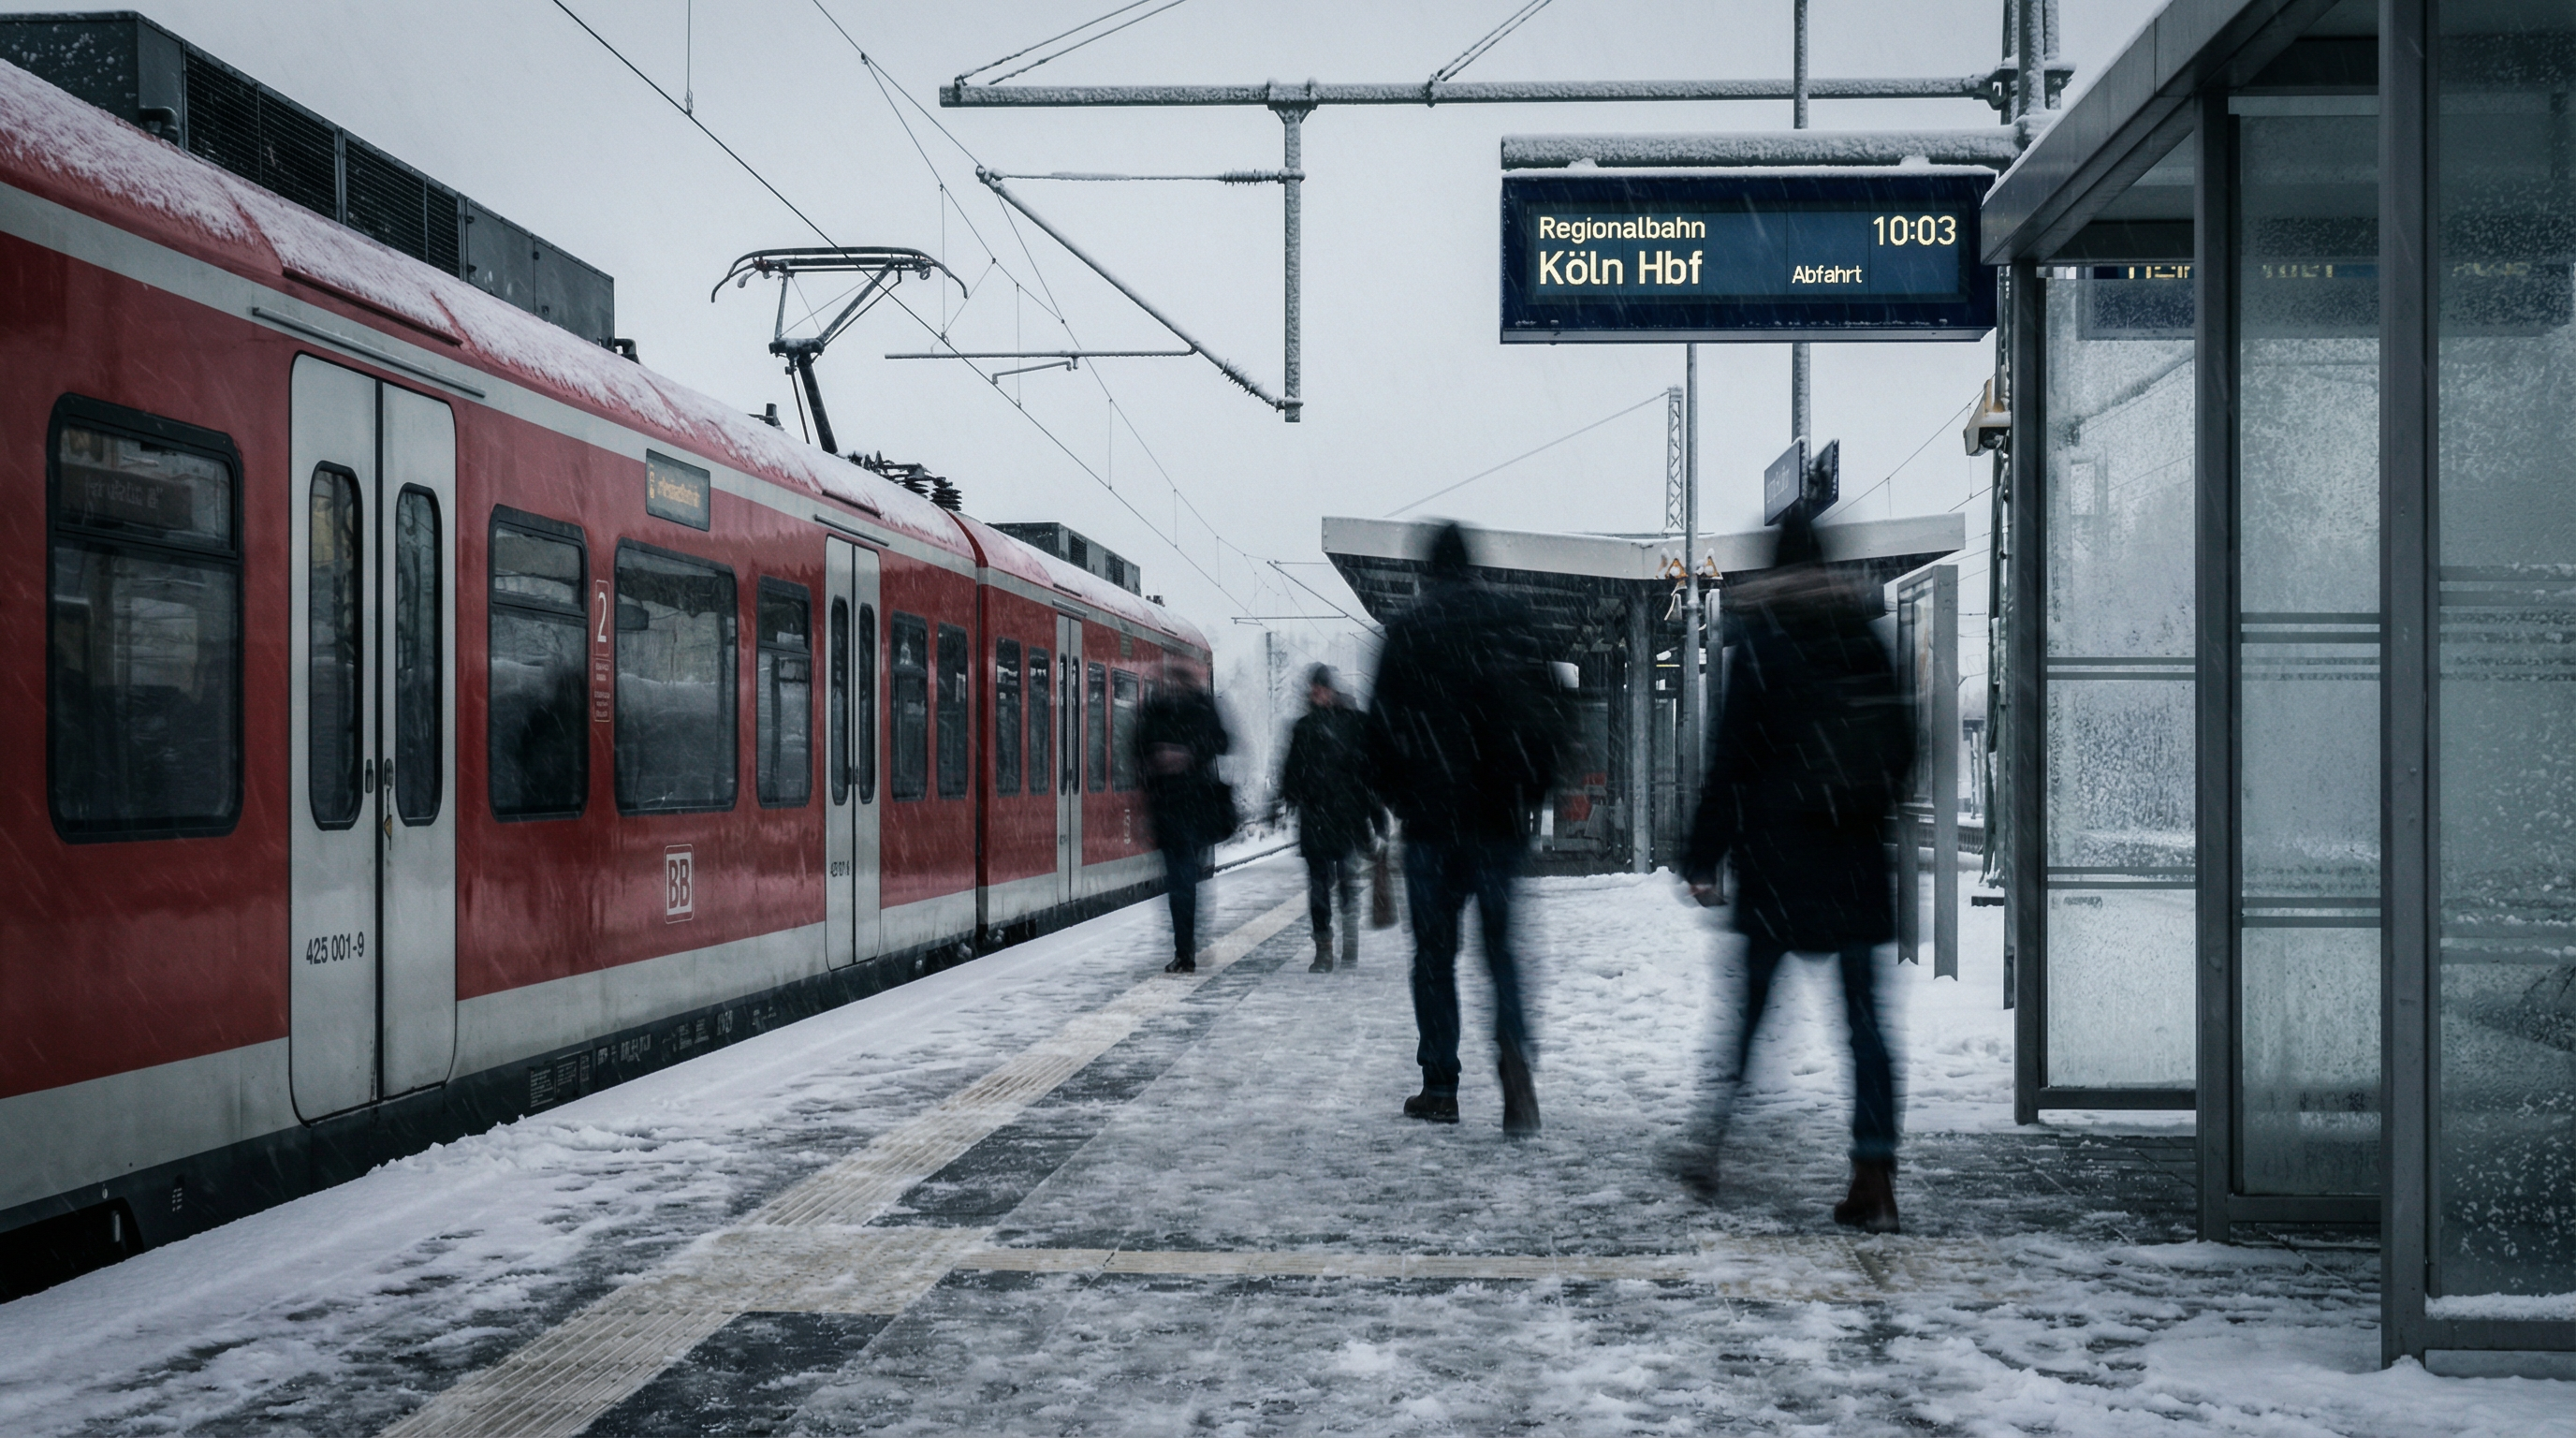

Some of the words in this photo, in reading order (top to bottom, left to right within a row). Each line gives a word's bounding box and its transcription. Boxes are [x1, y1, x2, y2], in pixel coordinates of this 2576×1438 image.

[1540, 216, 1705, 243] Regionalbahn
[1874, 215, 1955, 245] 10:03
[1540, 251, 1623, 285] Köln
[1639, 250, 1703, 285] Hbf
[1792, 265, 1862, 284] Abfahrt
[597, 591, 607, 643] 2
[667, 858, 691, 910] BB
[306, 936, 329, 965] 425
[331, 931, 365, 962] 001-9
